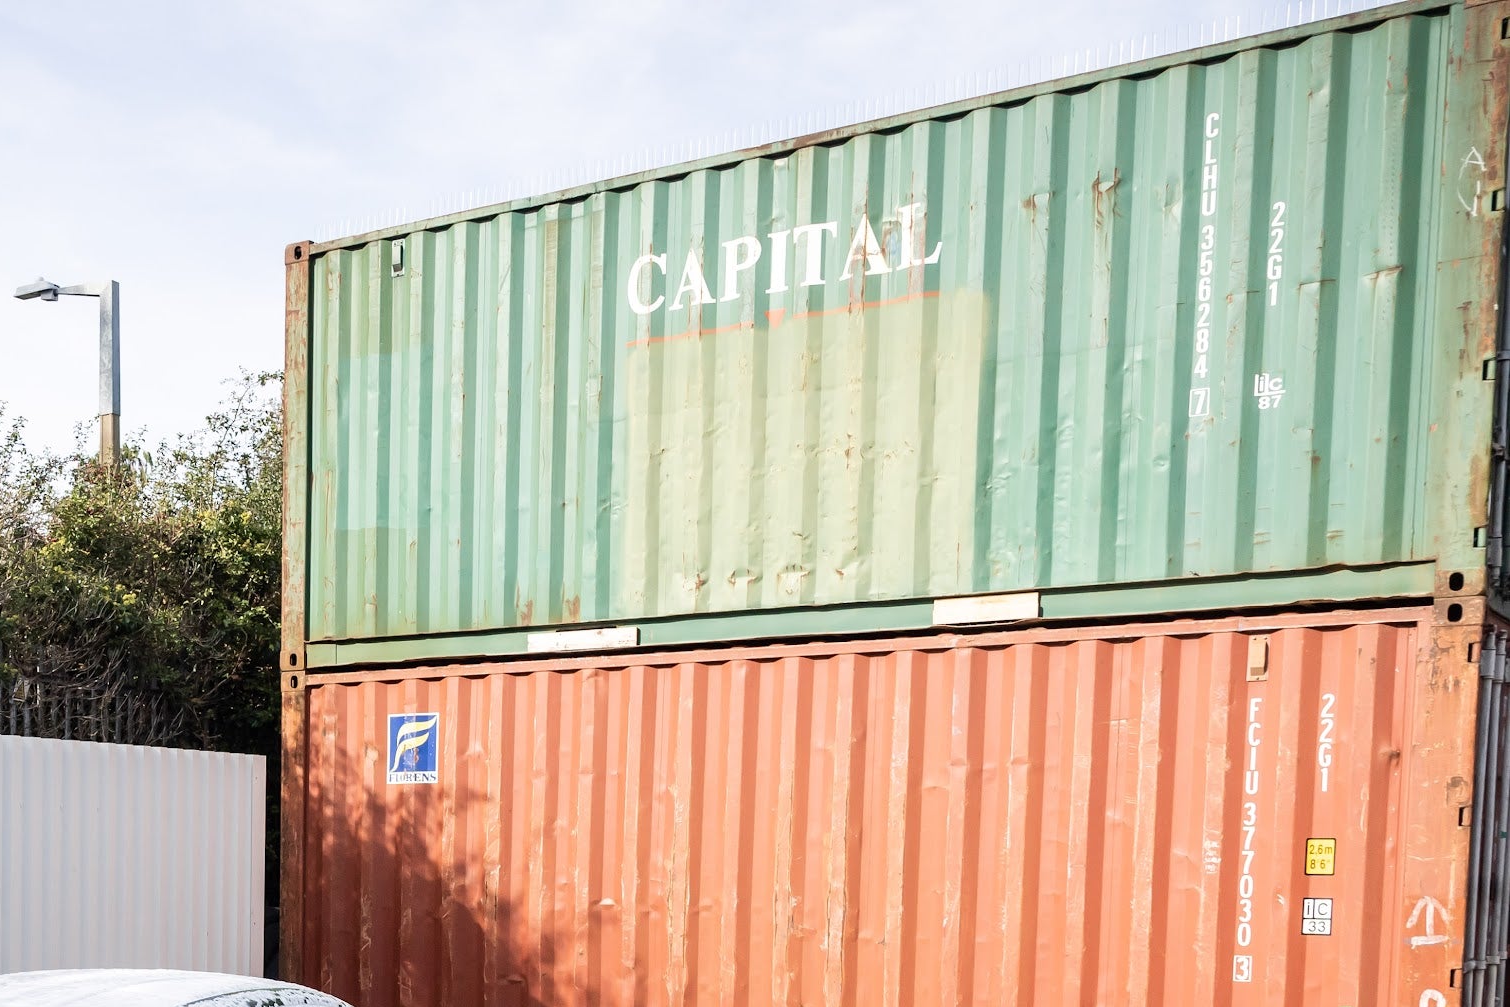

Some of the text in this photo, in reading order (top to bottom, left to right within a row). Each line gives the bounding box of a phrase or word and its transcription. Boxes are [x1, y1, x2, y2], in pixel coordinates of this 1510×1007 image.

[1201, 112, 1219, 216] CLHU
[626, 202, 943, 316] CAPITAL
[1193, 224, 1215, 378] 356284
[1267, 201, 1286, 306] 22G1
[1258, 394, 1282, 409] 87
[1245, 697, 1262, 795] FCIU
[1317, 693, 1335, 792] 22G1
[1237, 802, 1256, 947] 377030
[1308, 920, 1326, 932] 33
